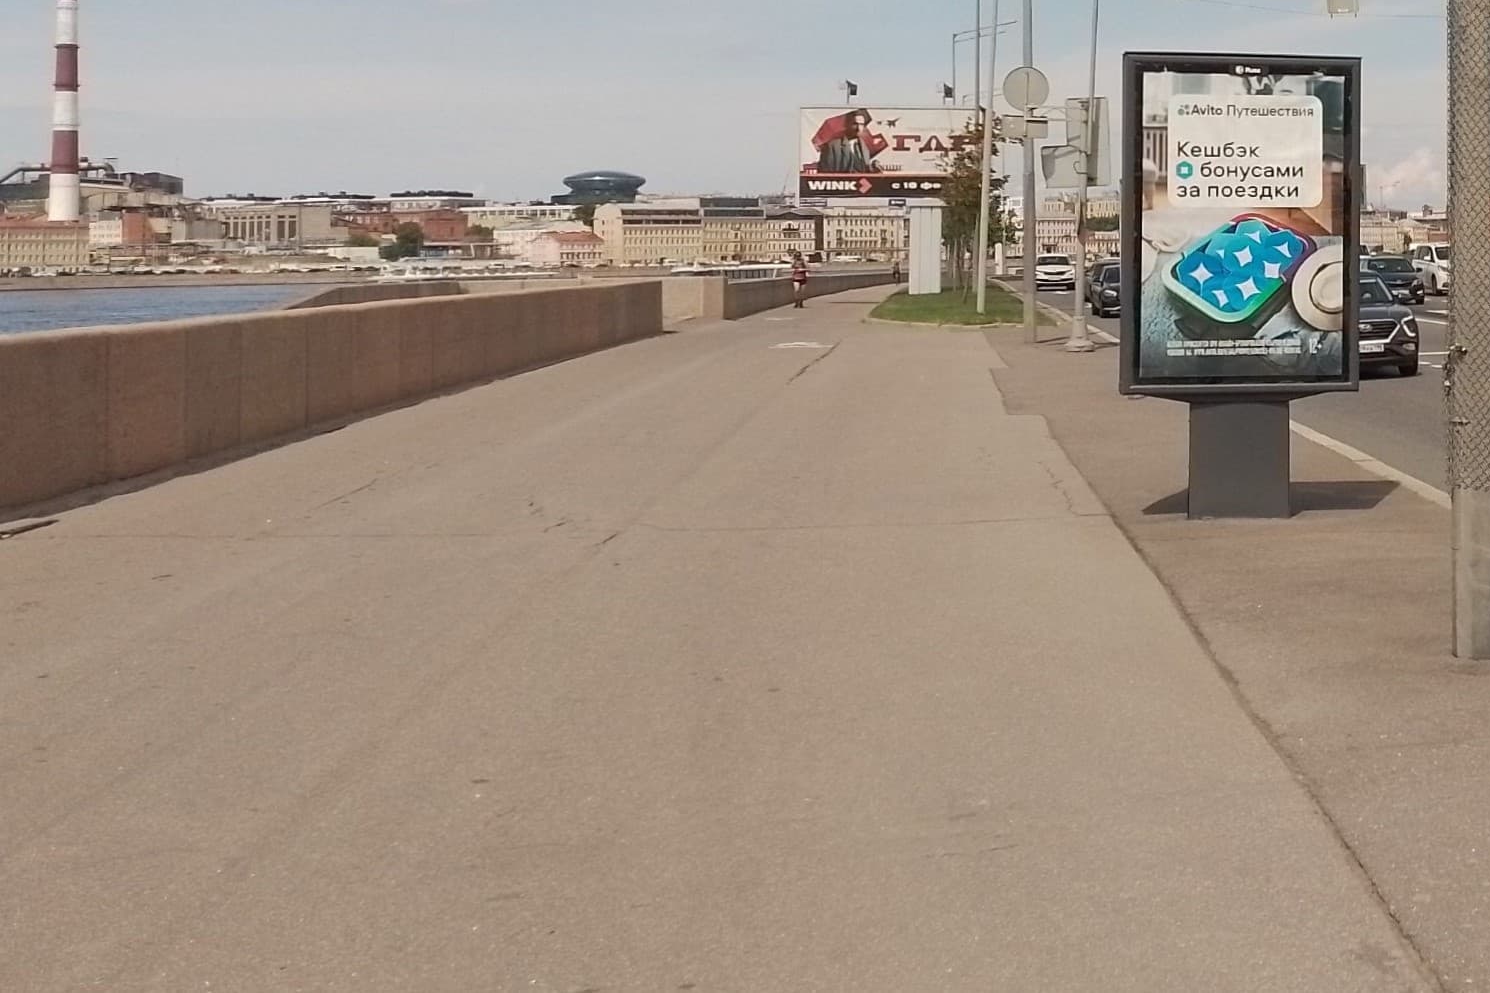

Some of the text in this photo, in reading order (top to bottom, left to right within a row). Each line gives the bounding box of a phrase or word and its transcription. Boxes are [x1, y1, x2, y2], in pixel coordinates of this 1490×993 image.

[1191, 104, 1314, 118] Avito Путешествия
[1176, 141, 1260, 158] Кешбэк
[1199, 161, 1304, 182] бонусами
[807, 180, 857, 191] WINK
[1176, 185, 1300, 200] за поездки
